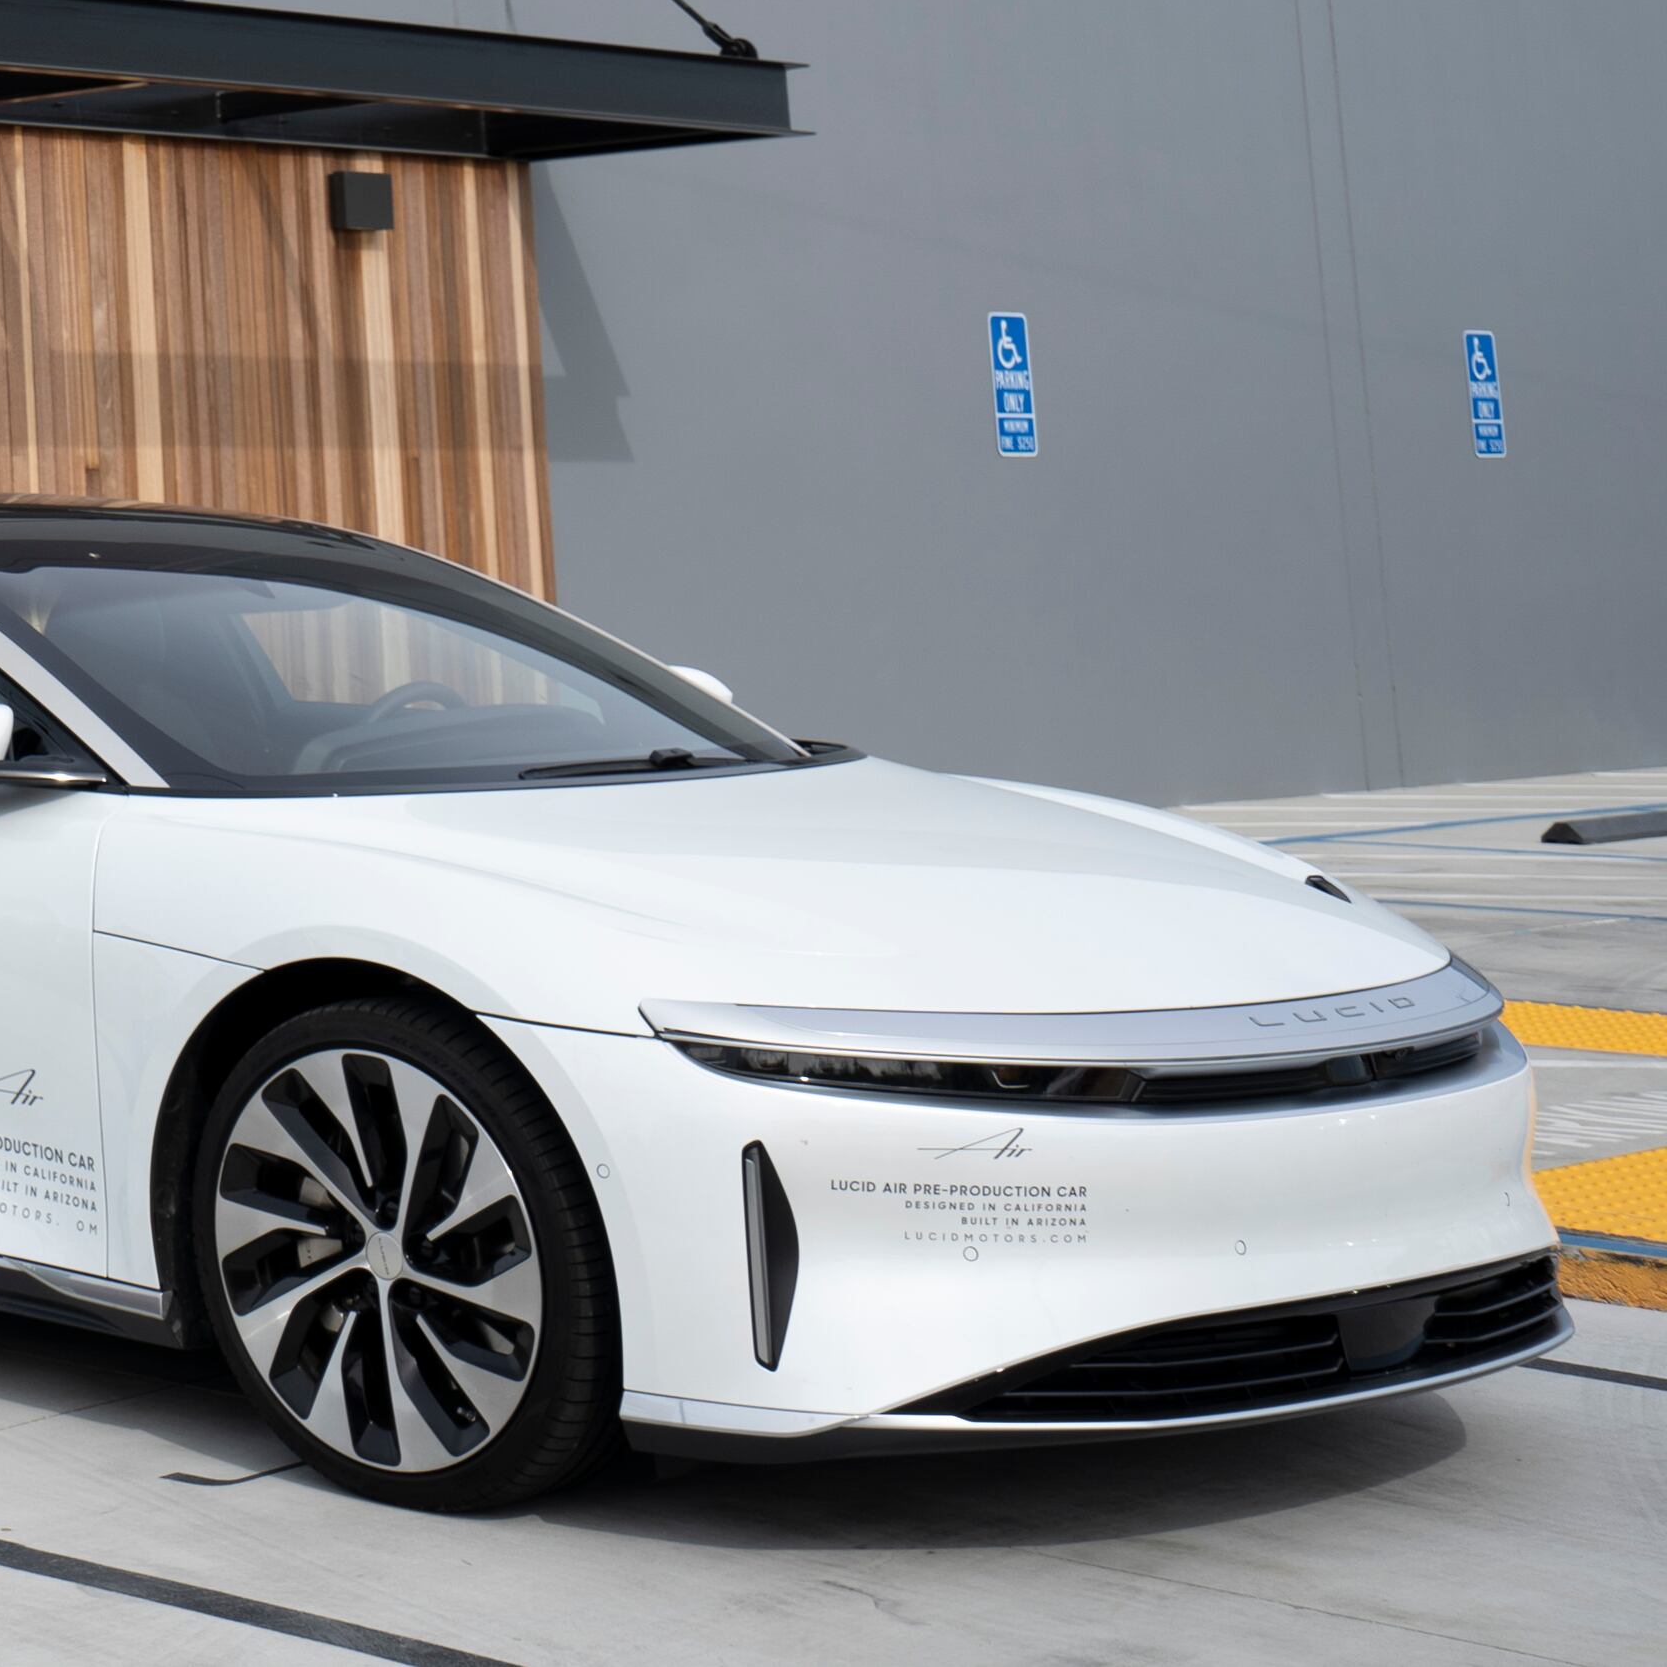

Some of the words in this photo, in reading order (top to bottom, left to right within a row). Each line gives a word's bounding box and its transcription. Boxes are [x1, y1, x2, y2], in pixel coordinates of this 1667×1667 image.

[1248, 996, 1416, 1027] LUCID
[916, 1127, 1033, 1160] Air
[67, 1152, 96, 1172] CAR
[5, 1160, 17, 1174] IN
[23, 1165, 97, 1193] CALIFORNIA
[25, 1184, 38, 1199] IN
[44, 1189, 97, 1213] ARIZONA
[830, 1179, 876, 1193] LUCID
[882, 1182, 907, 1195] AIR
[913, 1184, 1051, 1198] PRE-PRODUCTION
[1056, 1185, 1087, 1198] CAR
[904, 1200, 975, 1211] DESIGNED
[982, 1202, 997, 1212] IN
[1003, 1202, 1087, 1212] CALIFORNIA
[961, 1216, 998, 1226] BUILT
[1005, 1217, 1019, 1227] IN
[1027, 1218, 1087, 1227] ARIZONA
[904, 1231, 1087, 1244] LUCIDMOTORS.COM
